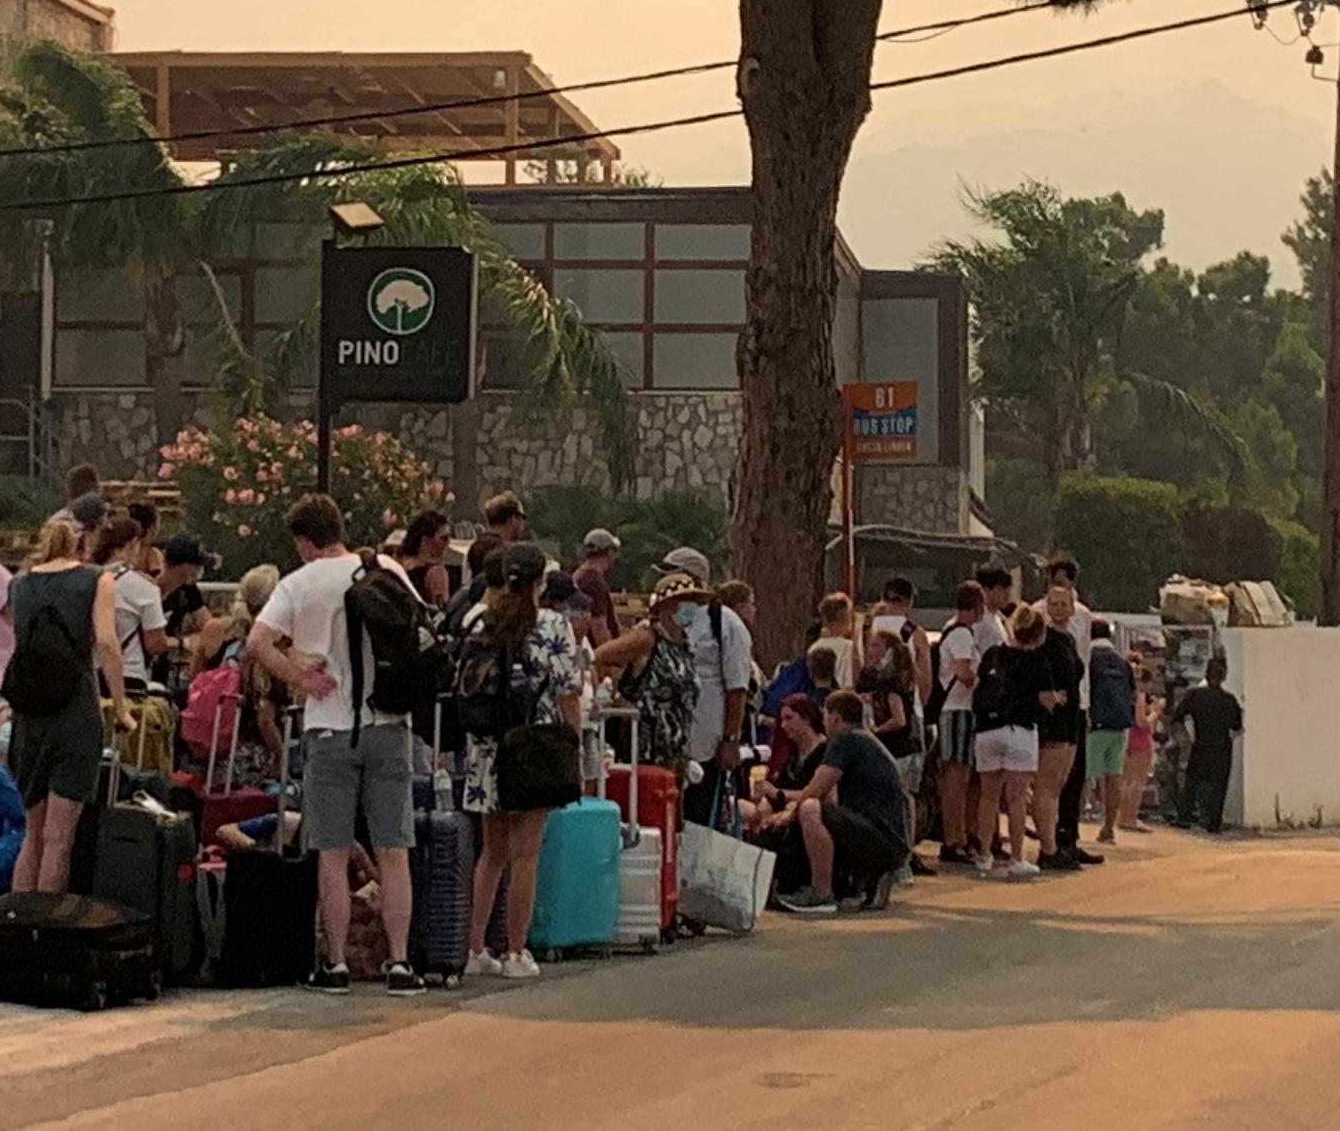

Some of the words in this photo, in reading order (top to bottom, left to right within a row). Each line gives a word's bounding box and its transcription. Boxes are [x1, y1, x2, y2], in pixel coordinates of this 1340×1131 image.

[338, 340, 400, 365] PINO
[875, 386, 895, 409] 61
[880, 415, 914, 435] STOP
